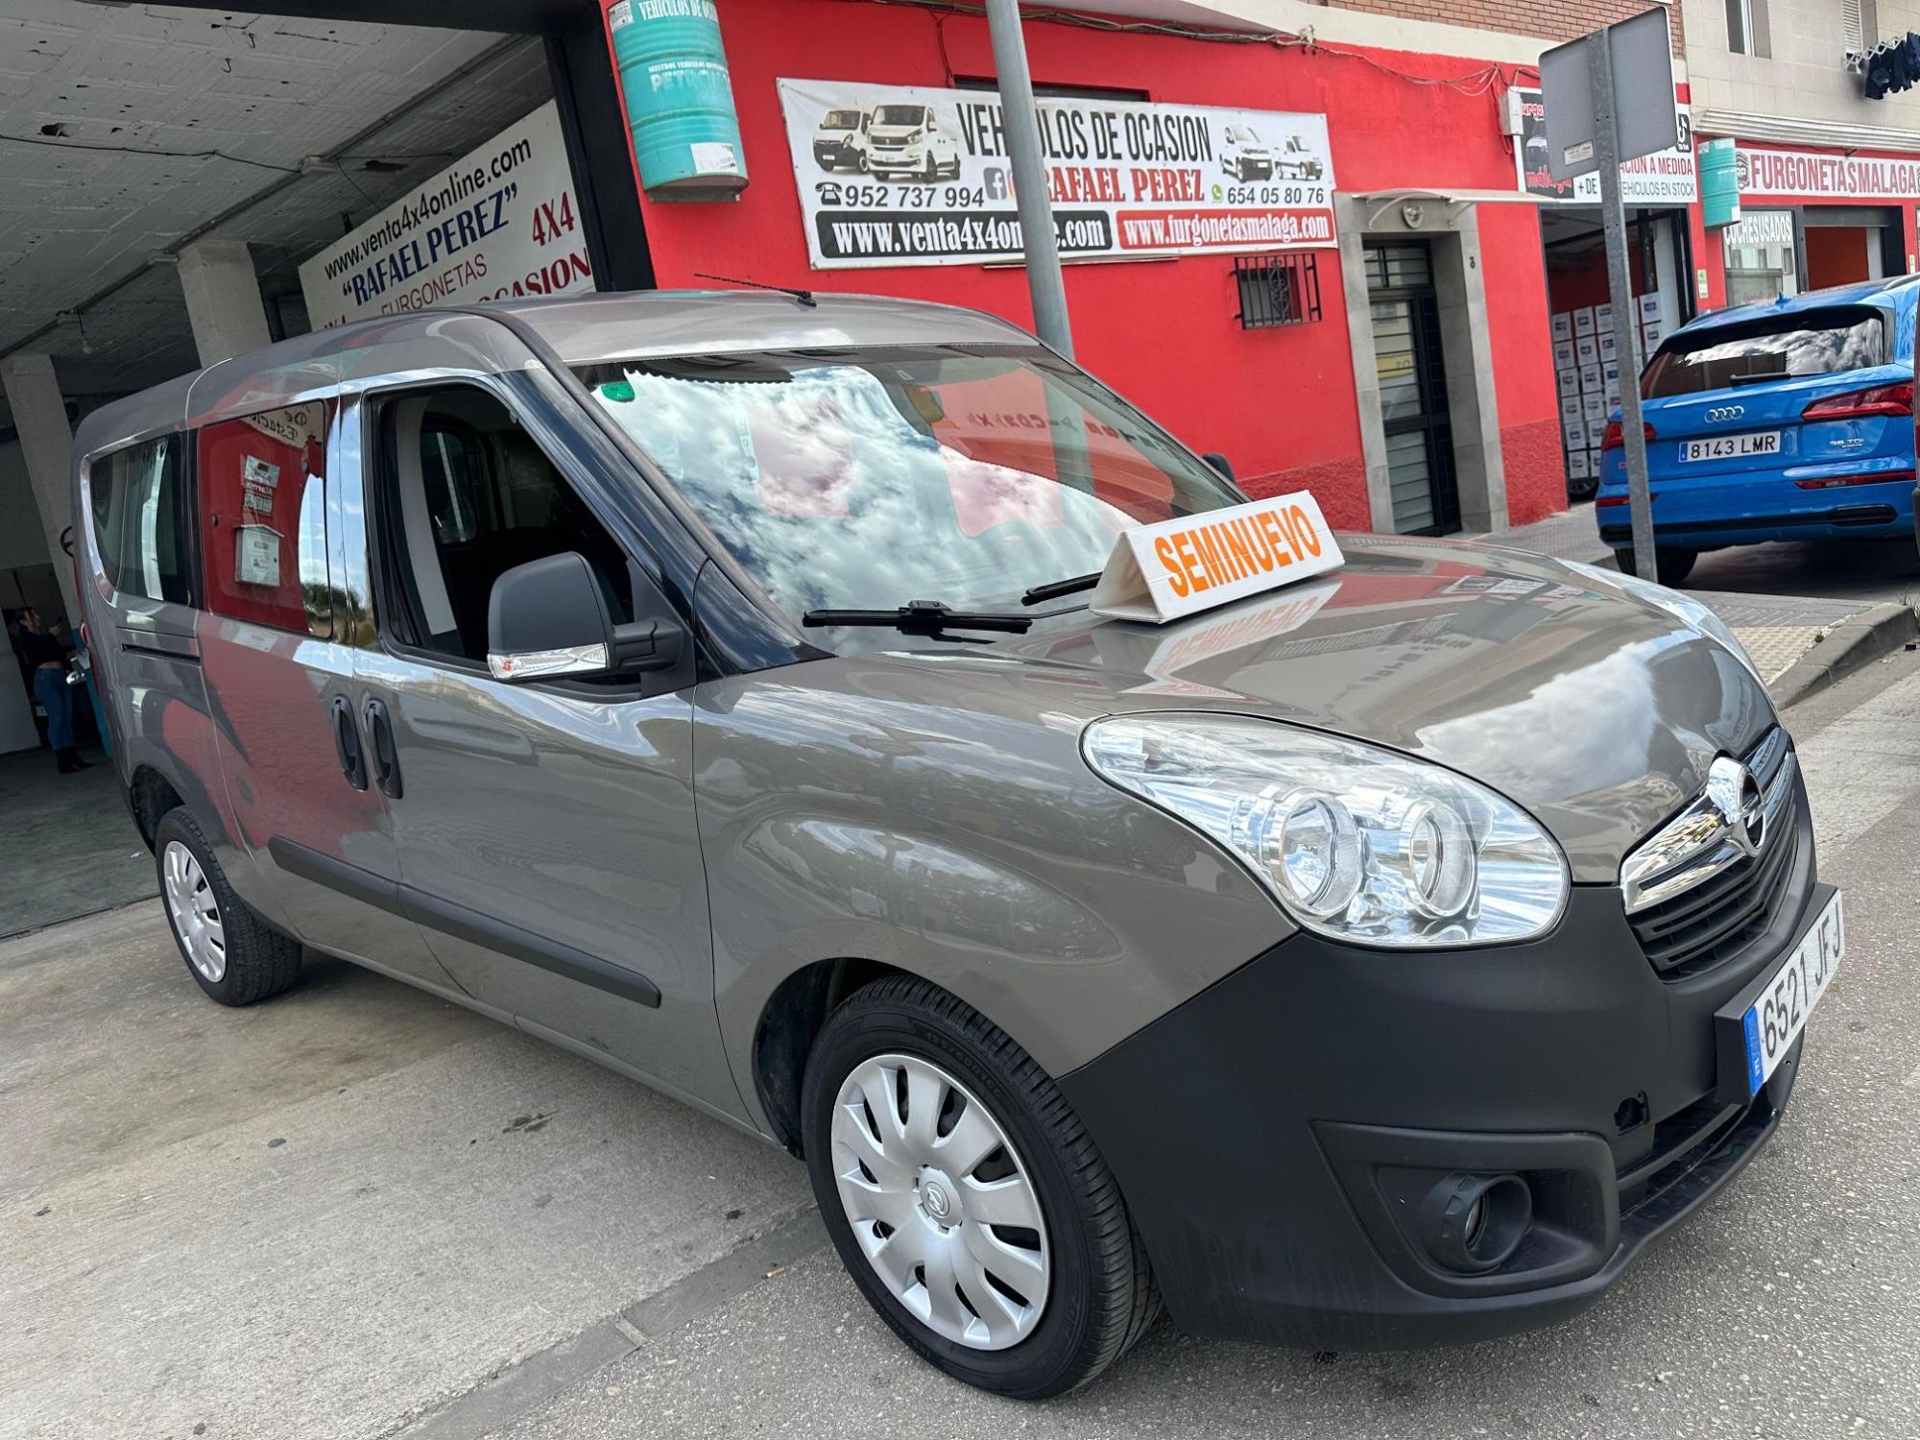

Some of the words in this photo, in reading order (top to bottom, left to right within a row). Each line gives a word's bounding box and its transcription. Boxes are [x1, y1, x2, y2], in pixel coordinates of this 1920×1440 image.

[956, 103, 1089, 160] VEHLOS
[1090, 111, 1122, 160] DE
[1124, 112, 1213, 163] OCASION
[1650, 157, 1657, 174] A
[1658, 157, 1693, 175] MEDIDA
[845, 186, 888, 207] 952
[897, 186, 937, 208] 737
[944, 187, 985, 208] 994
[1129, 168, 1205, 202] PEREZ
[1227, 187, 1255, 204] 654
[1260, 187, 1279, 204] 05
[1284, 187, 1302, 204] 80
[1307, 187, 1325, 204] 76
[1586, 178, 1598, 194] DE
[1622, 181, 1659, 196] EHICULOS
[1661, 181, 1671, 196] EN
[1672, 181, 1696, 197] STOCK
[324, 138, 532, 281] www.venta4x4online.com
[532, 191, 575, 246] 4X4
[1123, 213, 1330, 247] www.furgonetasmalaga.com
[479, 246, 592, 302] ASION
[1690, 439, 1735, 459] 8143
[1740, 434, 1775, 454] LMR
[1154, 504, 1322, 598] SEMINUEVO
[1763, 951, 1809, 1059] 6521
[1815, 902, 1841, 987] JFJ
